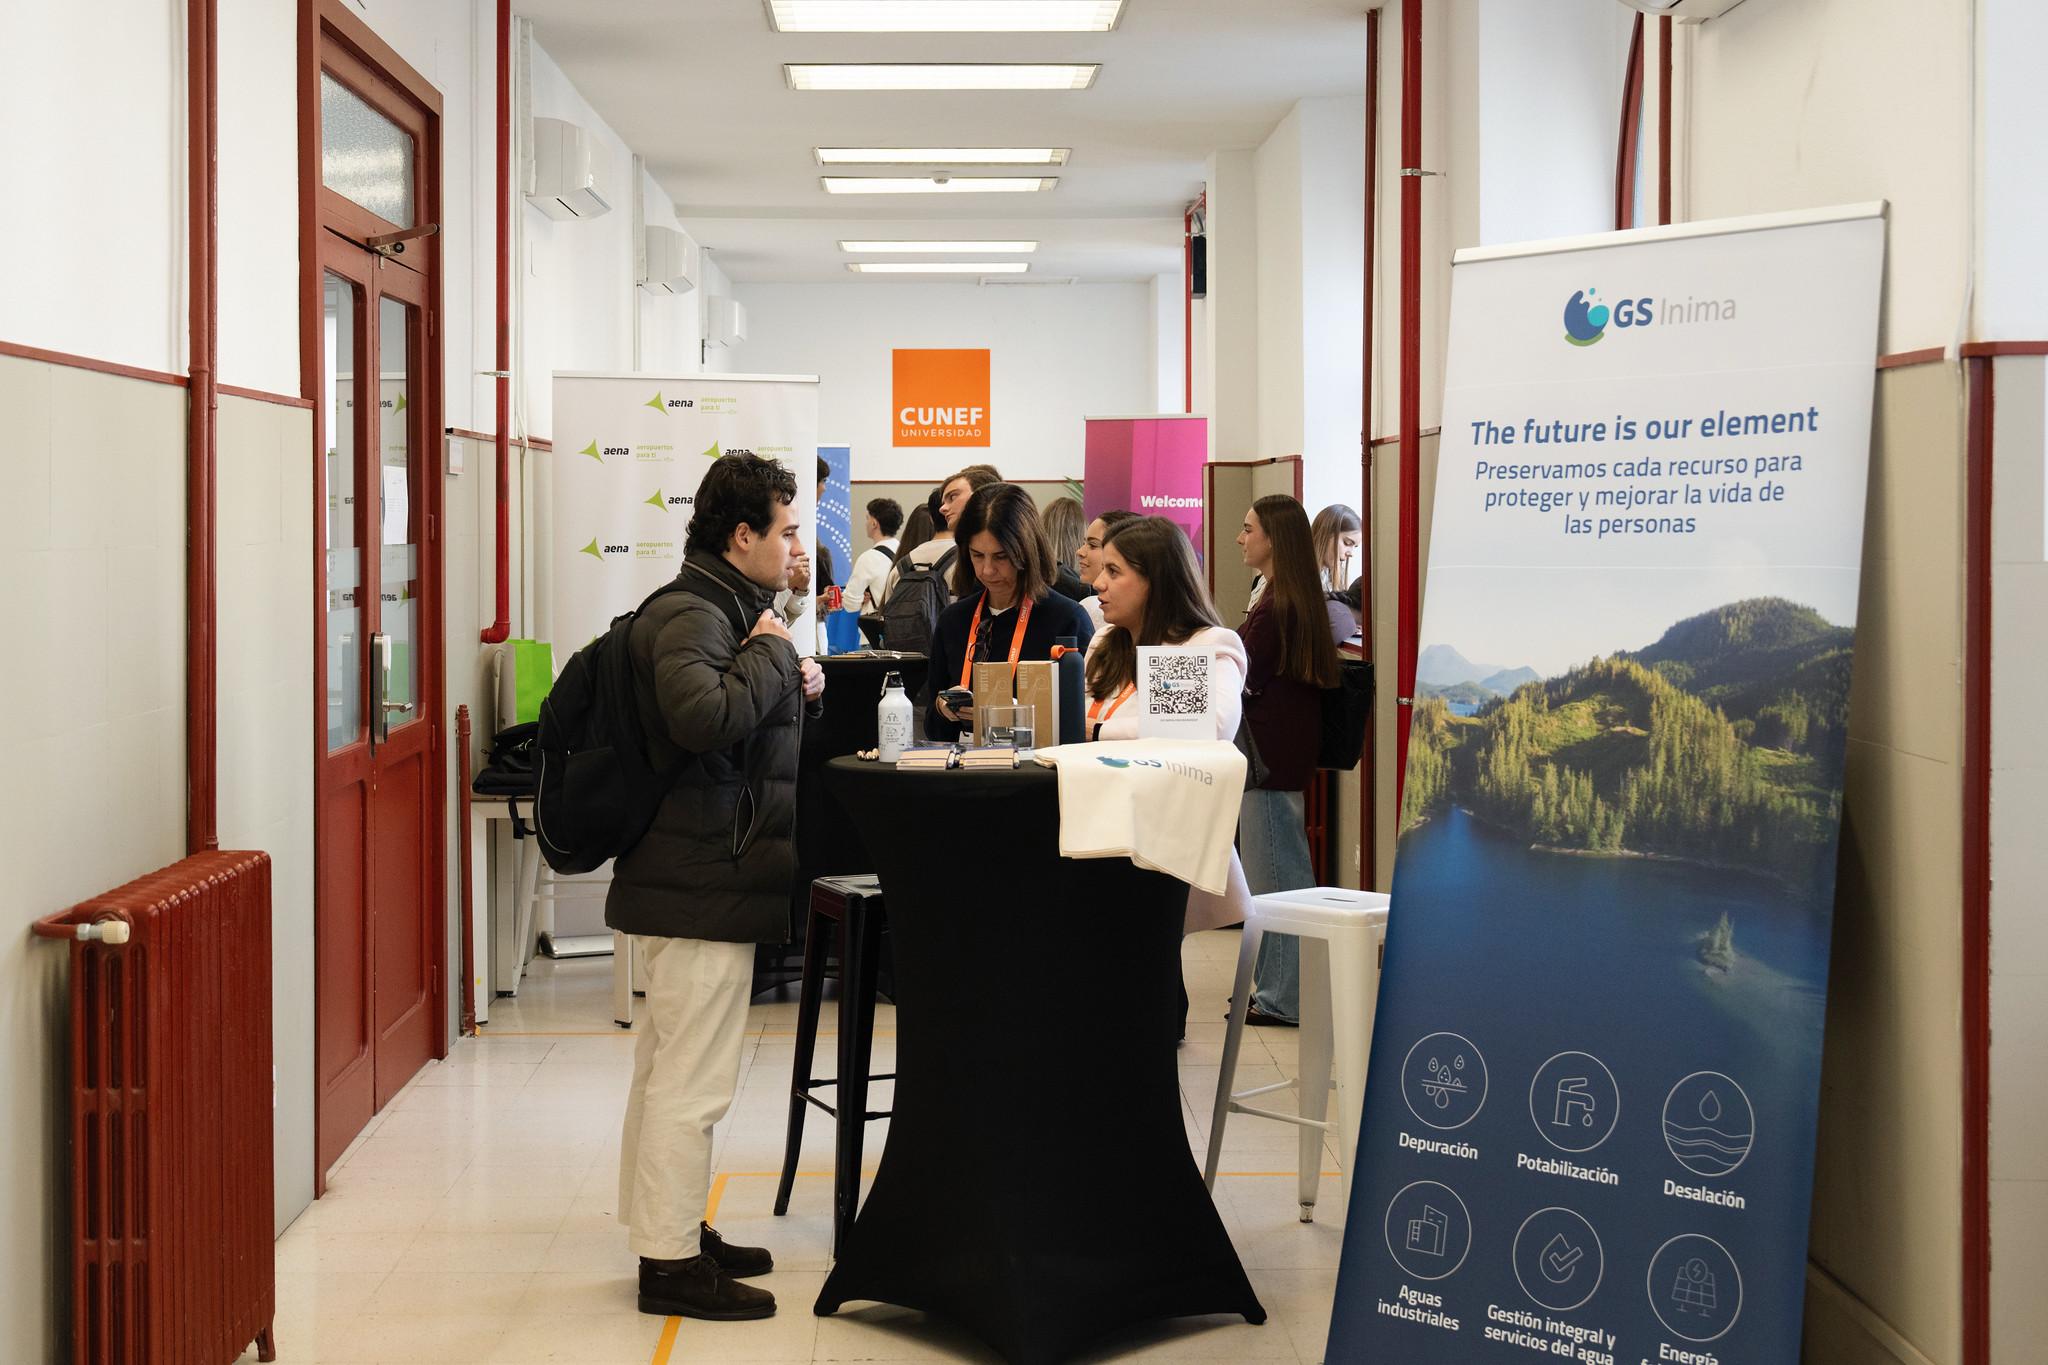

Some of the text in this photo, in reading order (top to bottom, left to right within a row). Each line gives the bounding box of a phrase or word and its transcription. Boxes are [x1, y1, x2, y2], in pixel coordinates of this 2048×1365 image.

[1613, 296, 1737, 328] GS Inima
[668, 399, 694, 408] aena
[900, 407, 983, 426] CUNEF
[901, 428, 982, 437] UNIVERSIDAD
[1471, 406, 1819, 445] The future is our element
[603, 447, 630, 456] aena
[1475, 454, 1803, 480] Preservamos cada recurso para
[668, 496, 694, 504] aena
[1485, 480, 1785, 512] proteger y mejorar la vida de
[1564, 514, 1697, 539] las personas
[603, 545, 629, 553] aena
[1399, 1132, 1478, 1160] Depuración
[1517, 1153, 1619, 1185] Potabilización
[1663, 1179, 1746, 1209] Desalación
[1399, 1285, 1442, 1307] Aguas
[1377, 1299, 1460, 1331] industriales
[1487, 1304, 1616, 1350] Gestión integral y
[1484, 1325, 1614, 1365] servicios del agua
